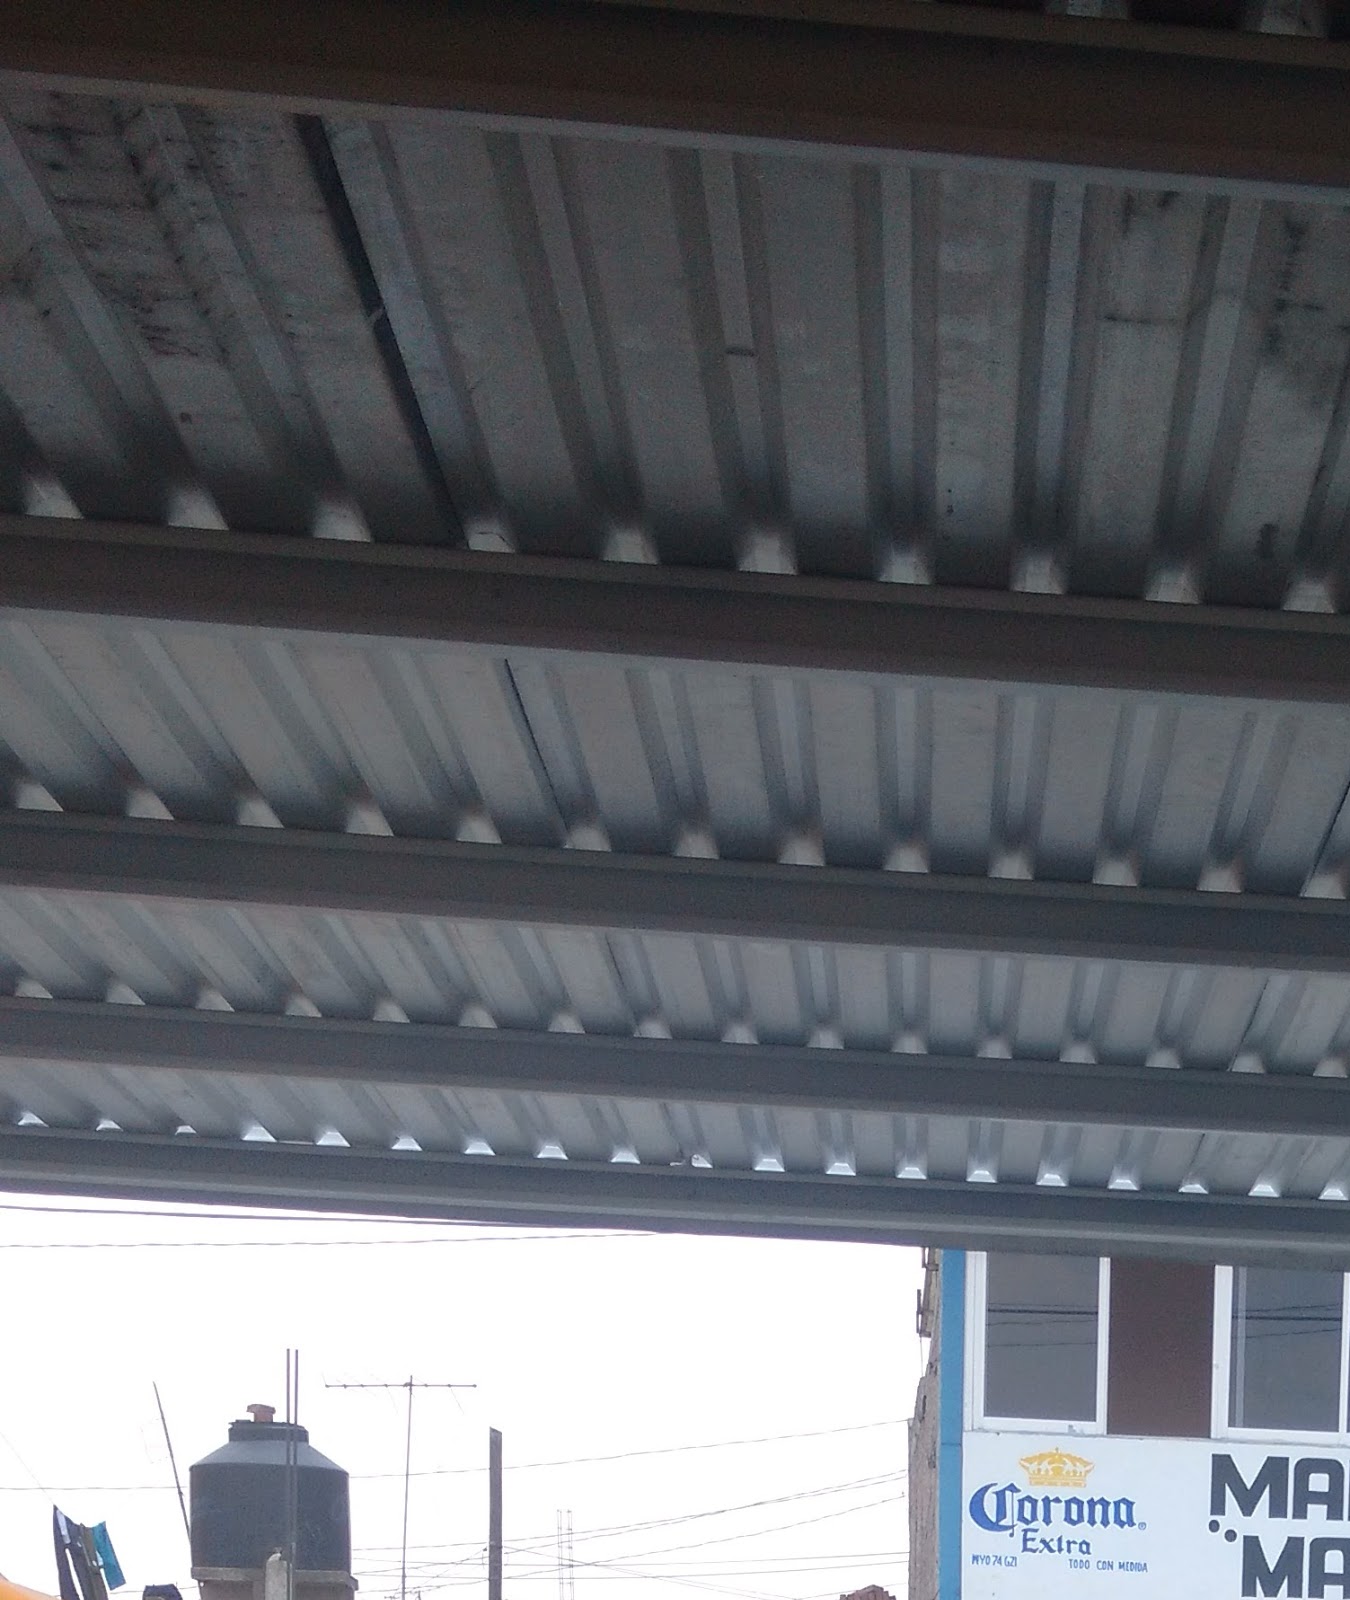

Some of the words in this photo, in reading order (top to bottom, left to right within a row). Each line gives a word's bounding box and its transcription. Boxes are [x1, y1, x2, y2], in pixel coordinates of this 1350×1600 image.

[1021, 1527, 1092, 1555] Extra
[1068, 1558, 1090, 1570] TODO
[1096, 1560, 1114, 1571] CON
[1118, 1561, 1149, 1573] MEDIDA
